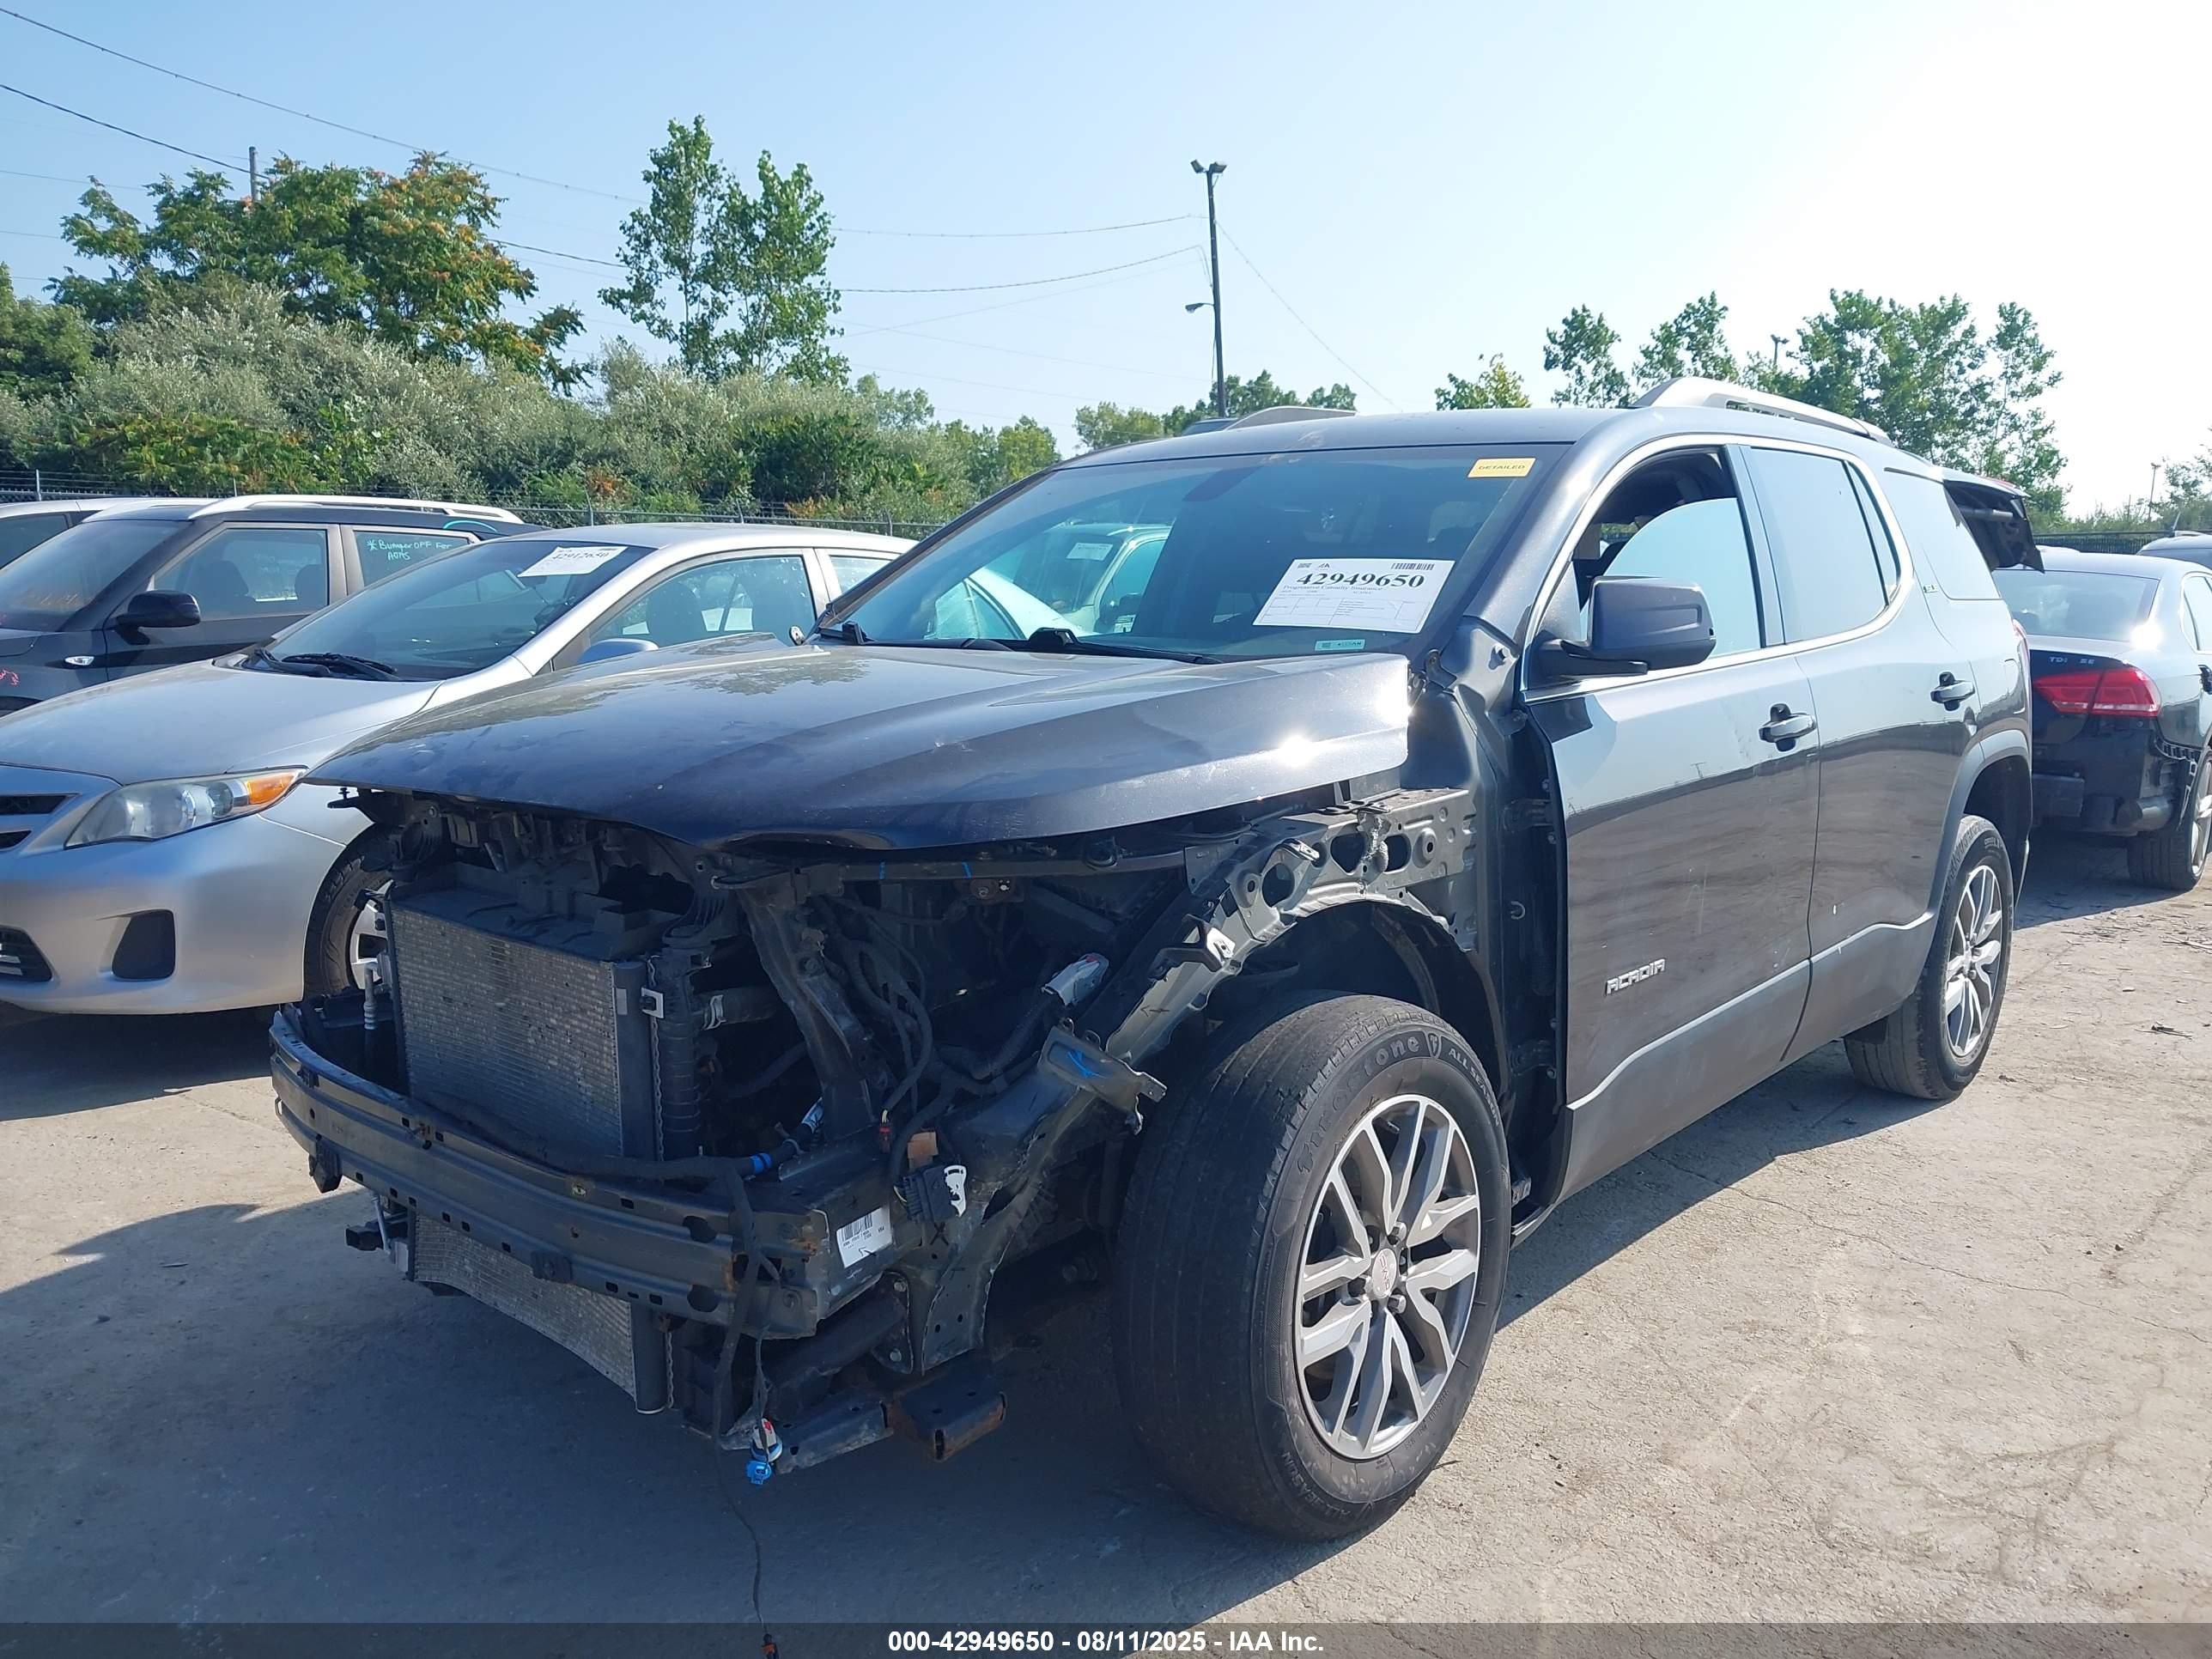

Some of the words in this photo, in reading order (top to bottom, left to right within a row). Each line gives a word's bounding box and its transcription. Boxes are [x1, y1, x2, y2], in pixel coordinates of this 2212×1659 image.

[1296, 573, 1425, 587] 42949650
[1607, 957, 1666, 994] ACADIA
[1448, 1048, 1469, 1070] ALL
[1469, 1065, 1500, 1127] SEASON
